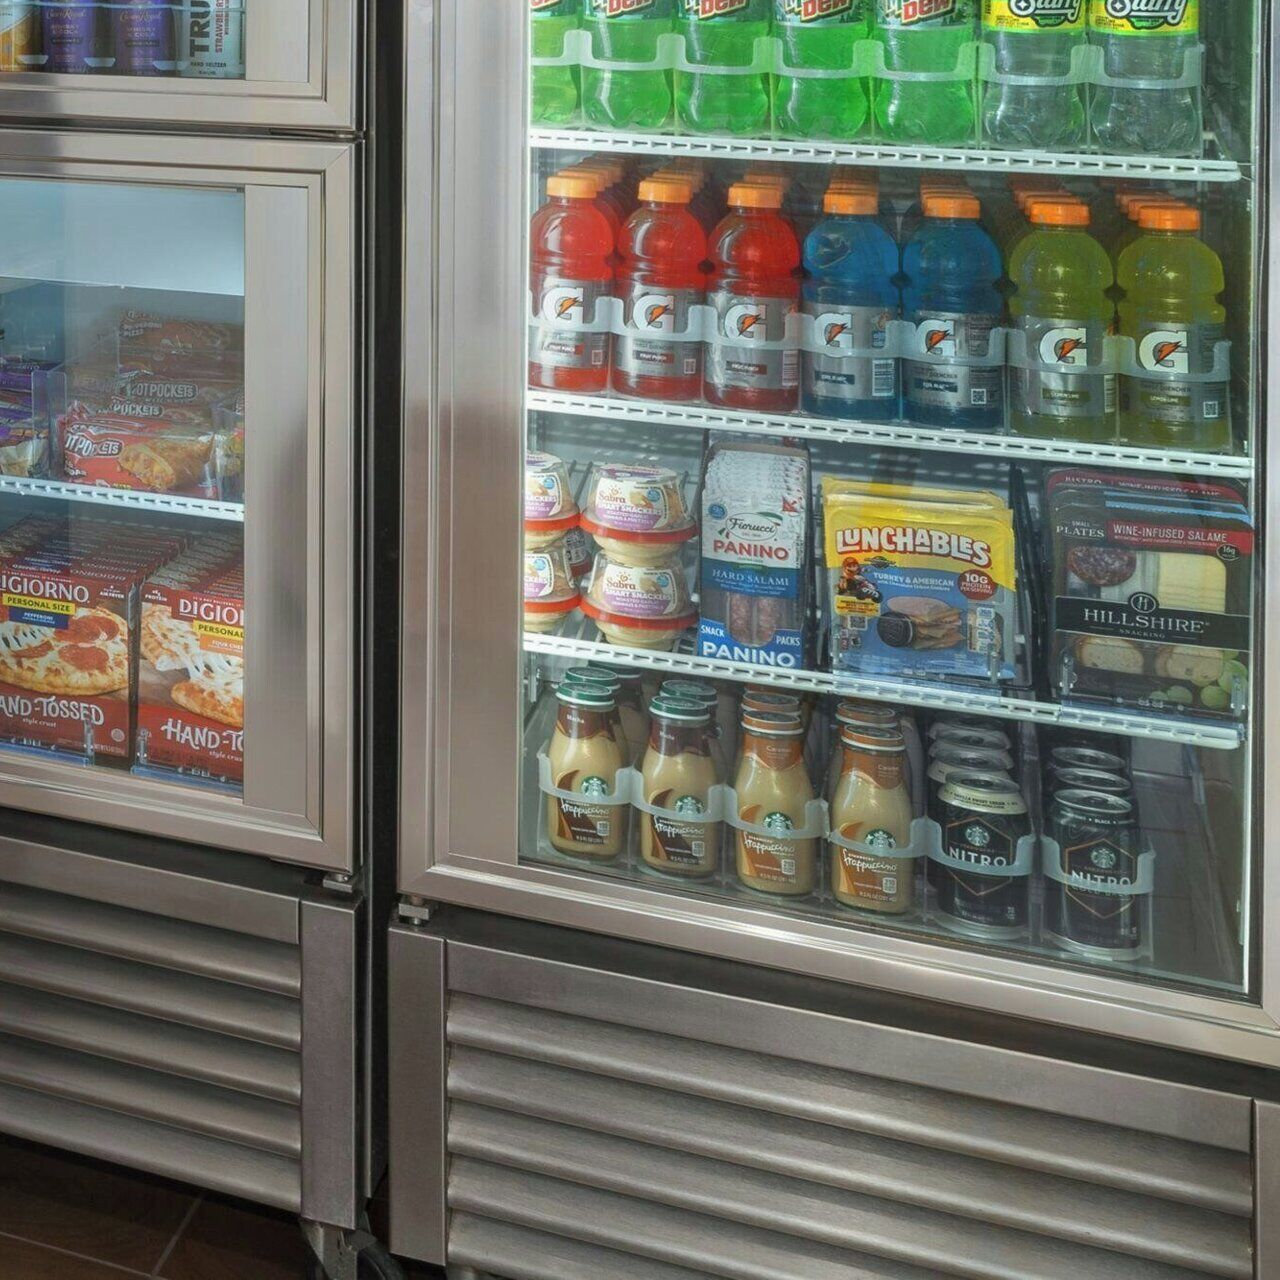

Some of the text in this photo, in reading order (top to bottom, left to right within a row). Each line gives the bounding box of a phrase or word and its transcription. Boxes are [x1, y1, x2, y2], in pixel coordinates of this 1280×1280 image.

[542, 287, 584, 321] G
[632, 293, 674, 333] G
[724, 303, 767, 343] G
[813, 312, 854, 349] G
[916, 320, 955, 358] G
[1040, 327, 1087, 368] G
[1139, 329, 1190, 374] G
[598, 490, 627, 505] Sabra
[729, 517, 776, 535] Fiorucci
[1055, 525, 1106, 538] PLATES
[1112, 523, 1185, 539] WINE-INFUSED
[1187, 529, 1228, 543] SALAME
[712, 540, 790, 562] PANINO
[835, 526, 992, 569] LUNCHABLES
[606, 576, 637, 592] Sabra
[712, 568, 790, 588] HARD SALAMI
[873, 571, 904, 584] TURKEY
[904, 575, 911, 585] &
[912, 576, 955, 588] AMERICAN
[964, 572, 989, 584] 10G
[7, 596, 71, 612] PERSONAL SIZE
[700, 623, 726, 638] SNACK
[1083, 608, 1205, 634] HILLSHIRE
[775, 634, 801, 647] PACKS
[1119, 627, 1166, 640] SNACKING
[701, 640, 796, 668] PANINO
[948, 846, 1008, 867] NITRO
